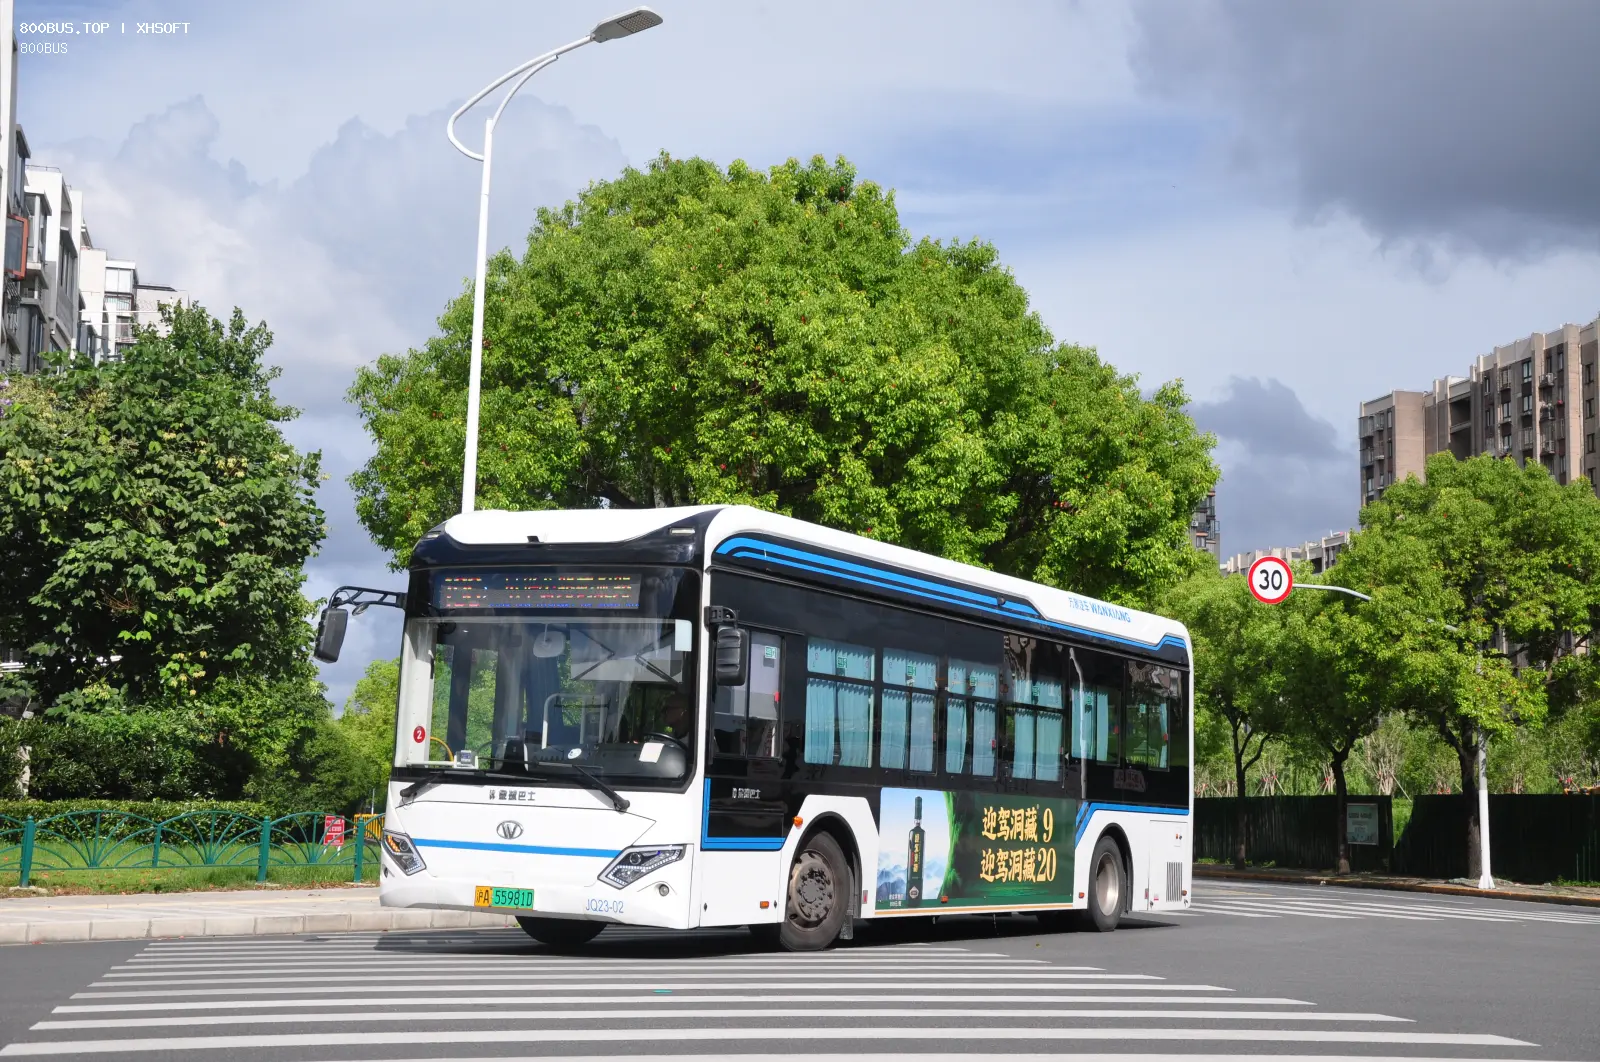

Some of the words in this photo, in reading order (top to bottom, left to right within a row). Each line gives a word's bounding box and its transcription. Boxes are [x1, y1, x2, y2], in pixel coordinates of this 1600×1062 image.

[1259, 569, 1283, 591] 30
[416, 730, 423, 740] 2
[981, 805, 1039, 843] 迎驾洞藏
[1042, 807, 1054, 843] 9
[585, 898, 625, 914] JQ23-02
